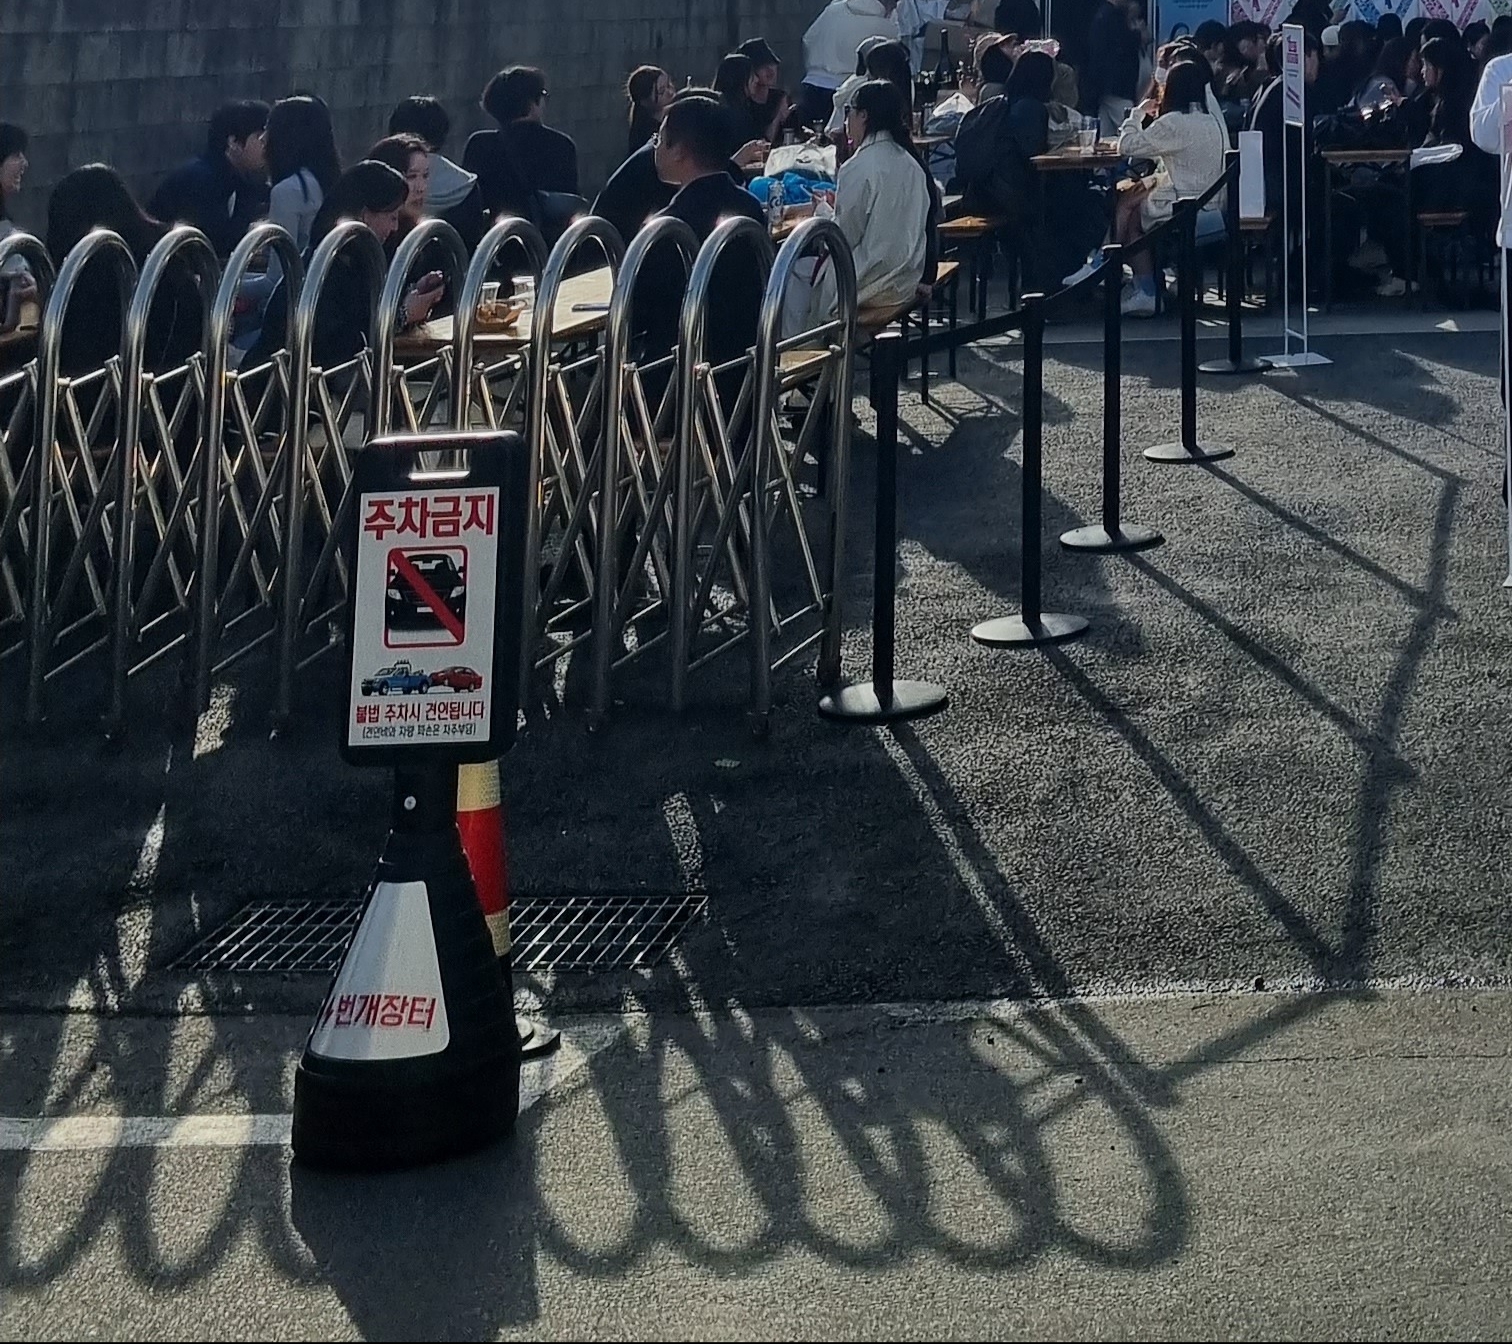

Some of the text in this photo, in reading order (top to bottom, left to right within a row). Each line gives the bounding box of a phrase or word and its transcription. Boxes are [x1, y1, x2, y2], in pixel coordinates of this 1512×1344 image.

[364, 494, 495, 541] 주차금지
[356, 700, 485, 723] 불법 주차시 견인됩니다
[334, 993, 437, 1029] 번개장터
